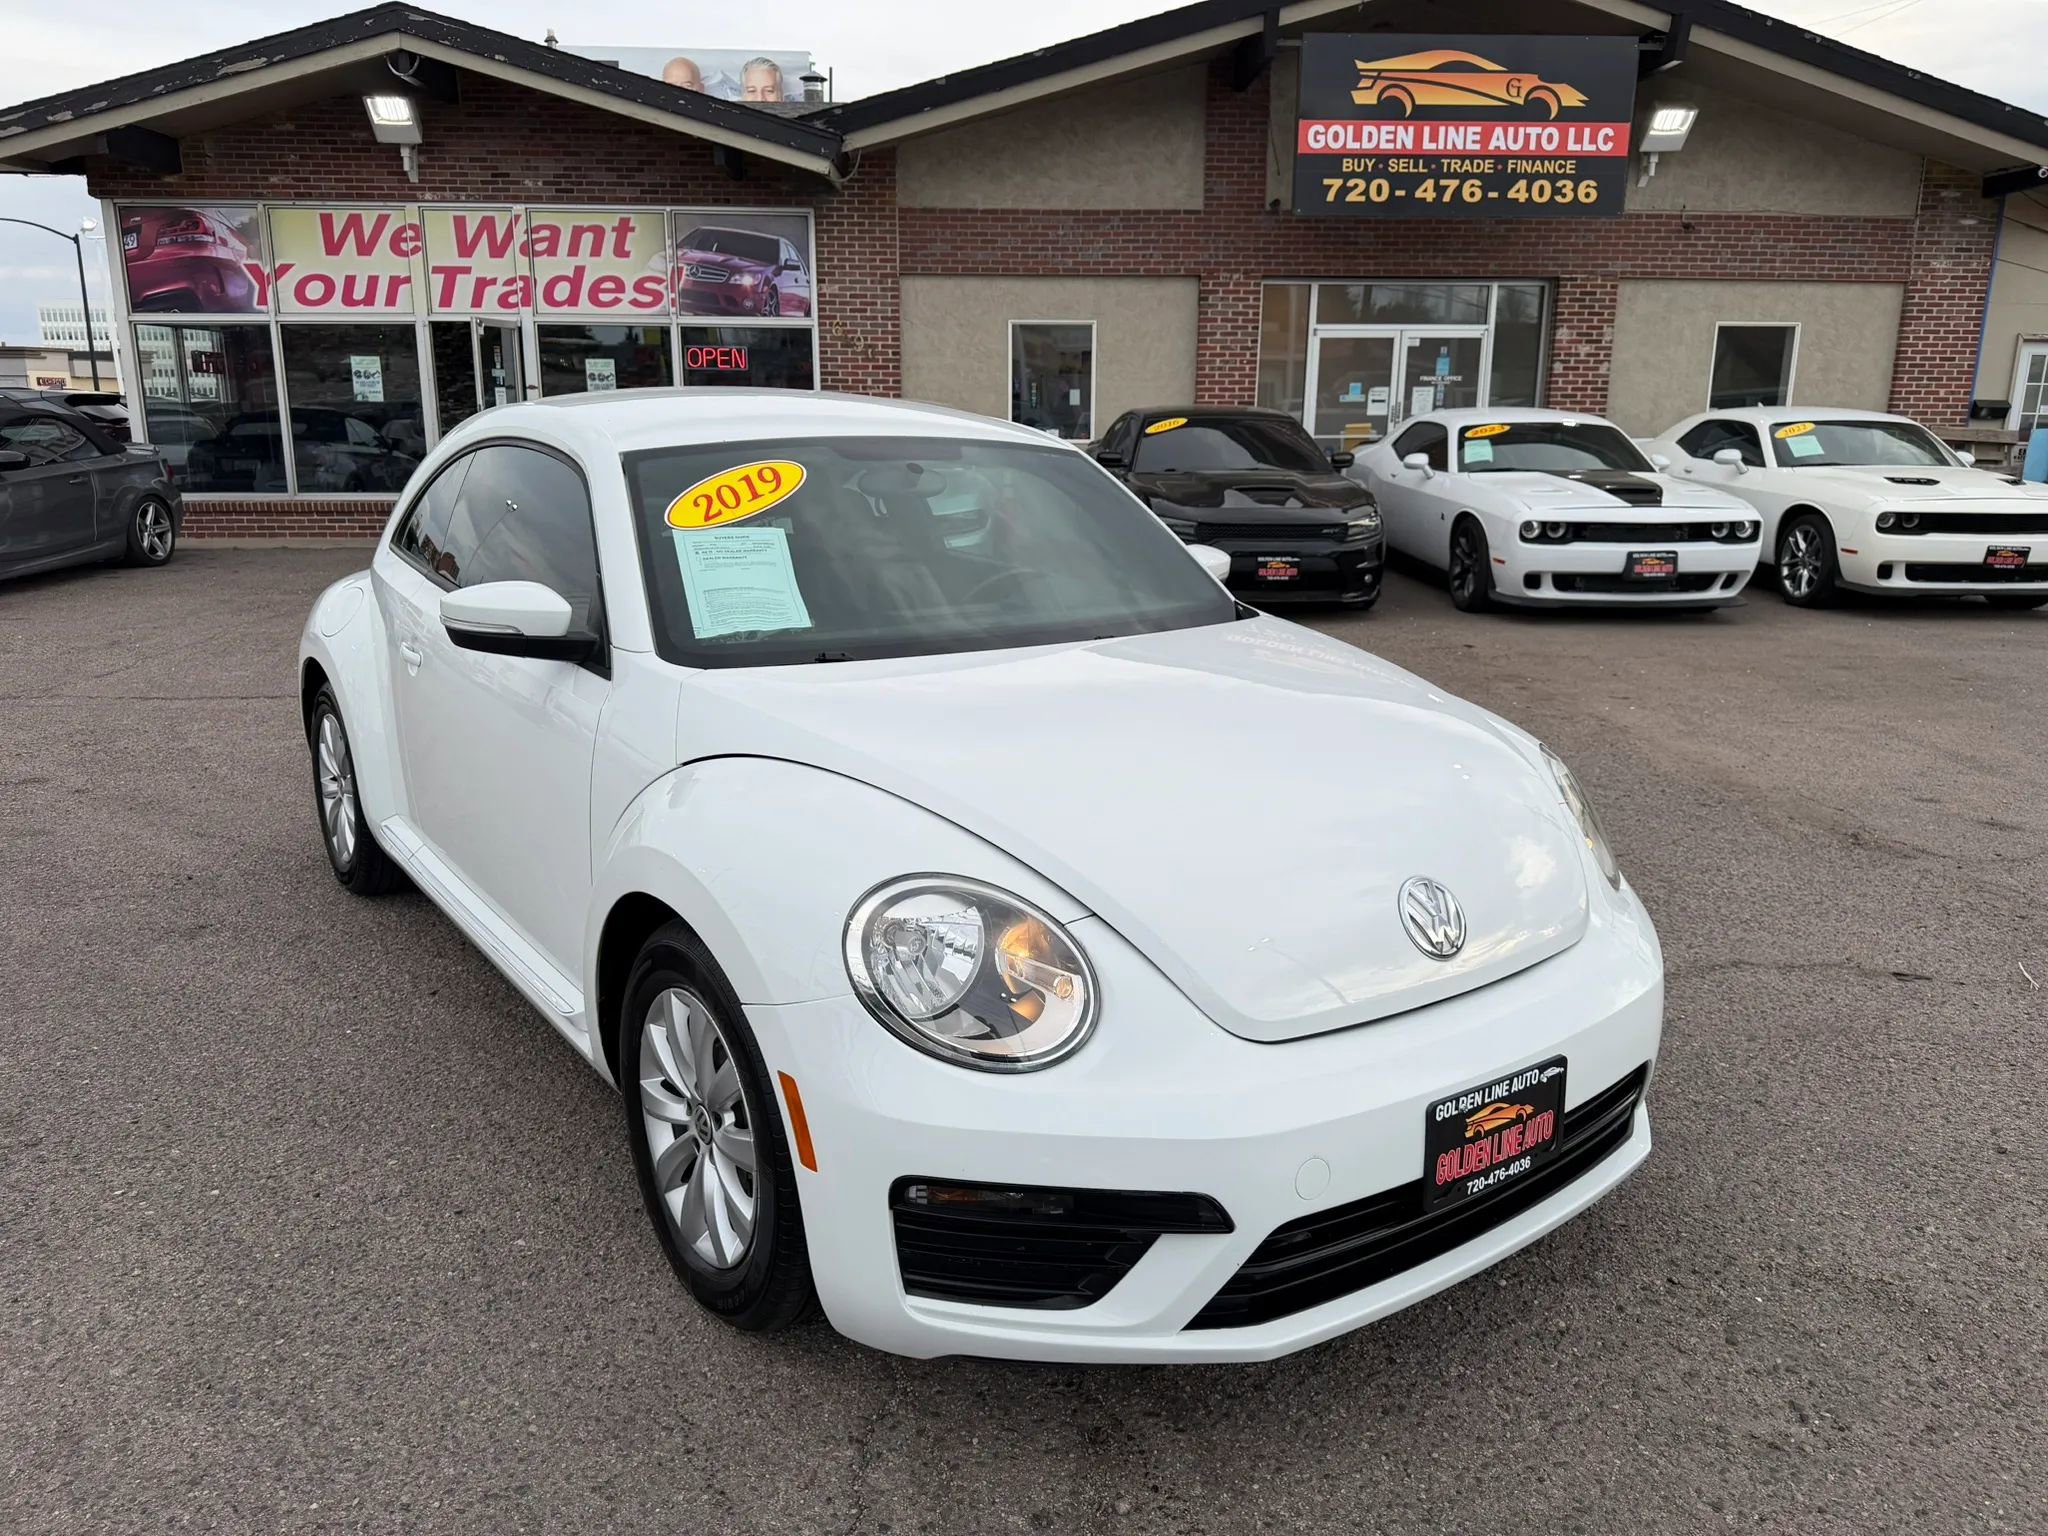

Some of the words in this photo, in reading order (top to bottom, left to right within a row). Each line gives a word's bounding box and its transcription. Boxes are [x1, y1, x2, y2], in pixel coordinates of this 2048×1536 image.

[1505, 78, 1522, 98] G
[1307, 125, 1414, 150] GOLDEN
[1422, 125, 1481, 150] LINE
[1488, 127, 1559, 151] AUTO
[1567, 127, 1615, 152] LLC
[1342, 159, 1376, 173] BUY
[1388, 159, 1428, 173] SELL
[1441, 160, 1494, 174] TRADE
[1507, 160, 1576, 174] FINANCE
[318, 212, 422, 258] We
[452, 214, 637, 259] Want
[242, 262, 413, 308] Your
[687, 347, 746, 369] OPEN
[692, 466, 783, 523] 2019
[1436, 1089, 1484, 1122] GOLDEN
[1484, 1080, 1510, 1103] LINE
[1511, 1069, 1540, 1092] AUTO
[1435, 1133, 1492, 1185] GOLDEN
[1492, 1123, 1524, 1164] LINE
[1522, 1110, 1554, 1151] AUTO
[1466, 1156, 1531, 1195] 720-476-4036
